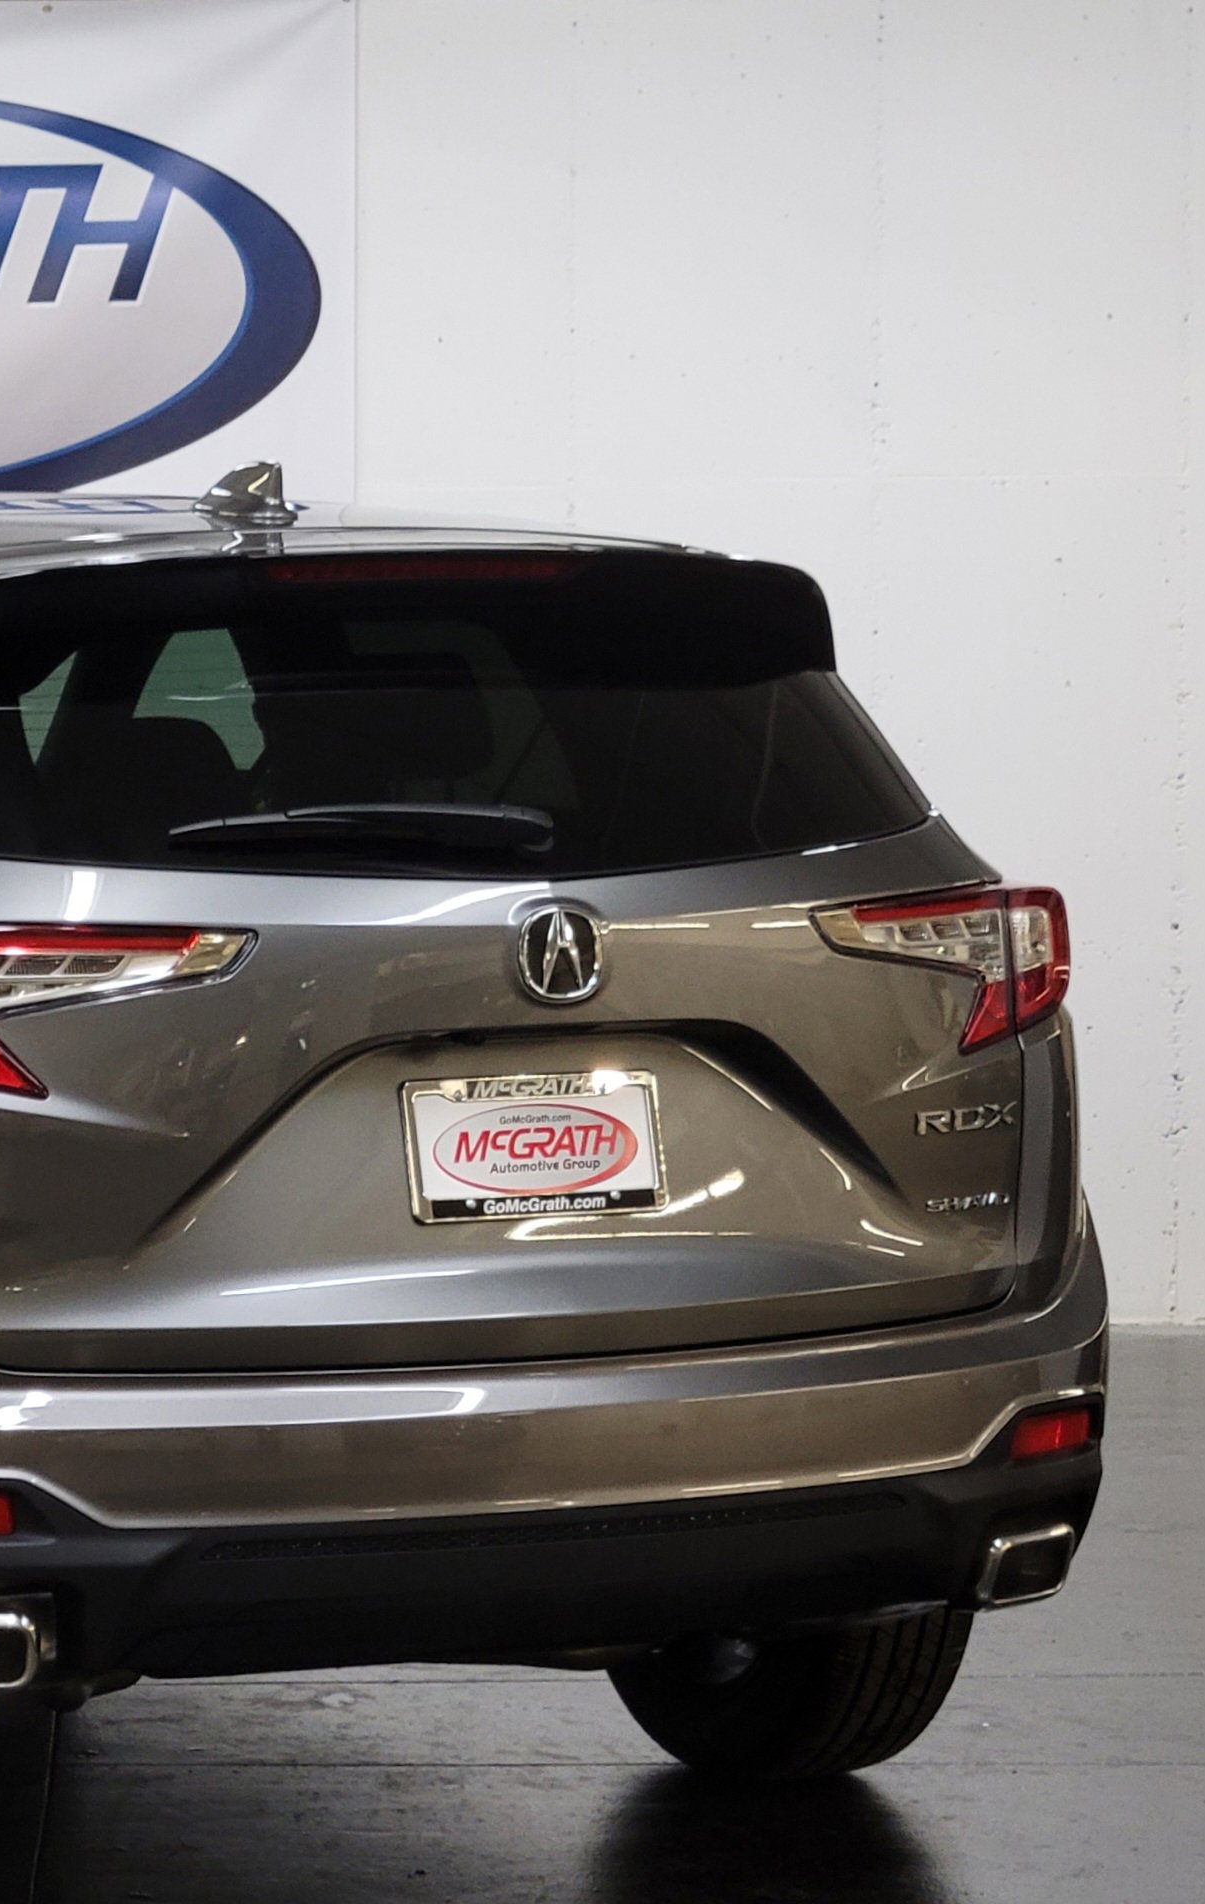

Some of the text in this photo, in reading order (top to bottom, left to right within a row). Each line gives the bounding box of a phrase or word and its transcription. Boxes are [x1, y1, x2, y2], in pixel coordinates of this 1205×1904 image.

[499, 1114, 572, 1126] GoMcGrath.com
[916, 1101, 1016, 1135] RDX
[490, 1158, 601, 1175] Automotive Group
[483, 1194, 606, 1215] GoMcGrath.com
